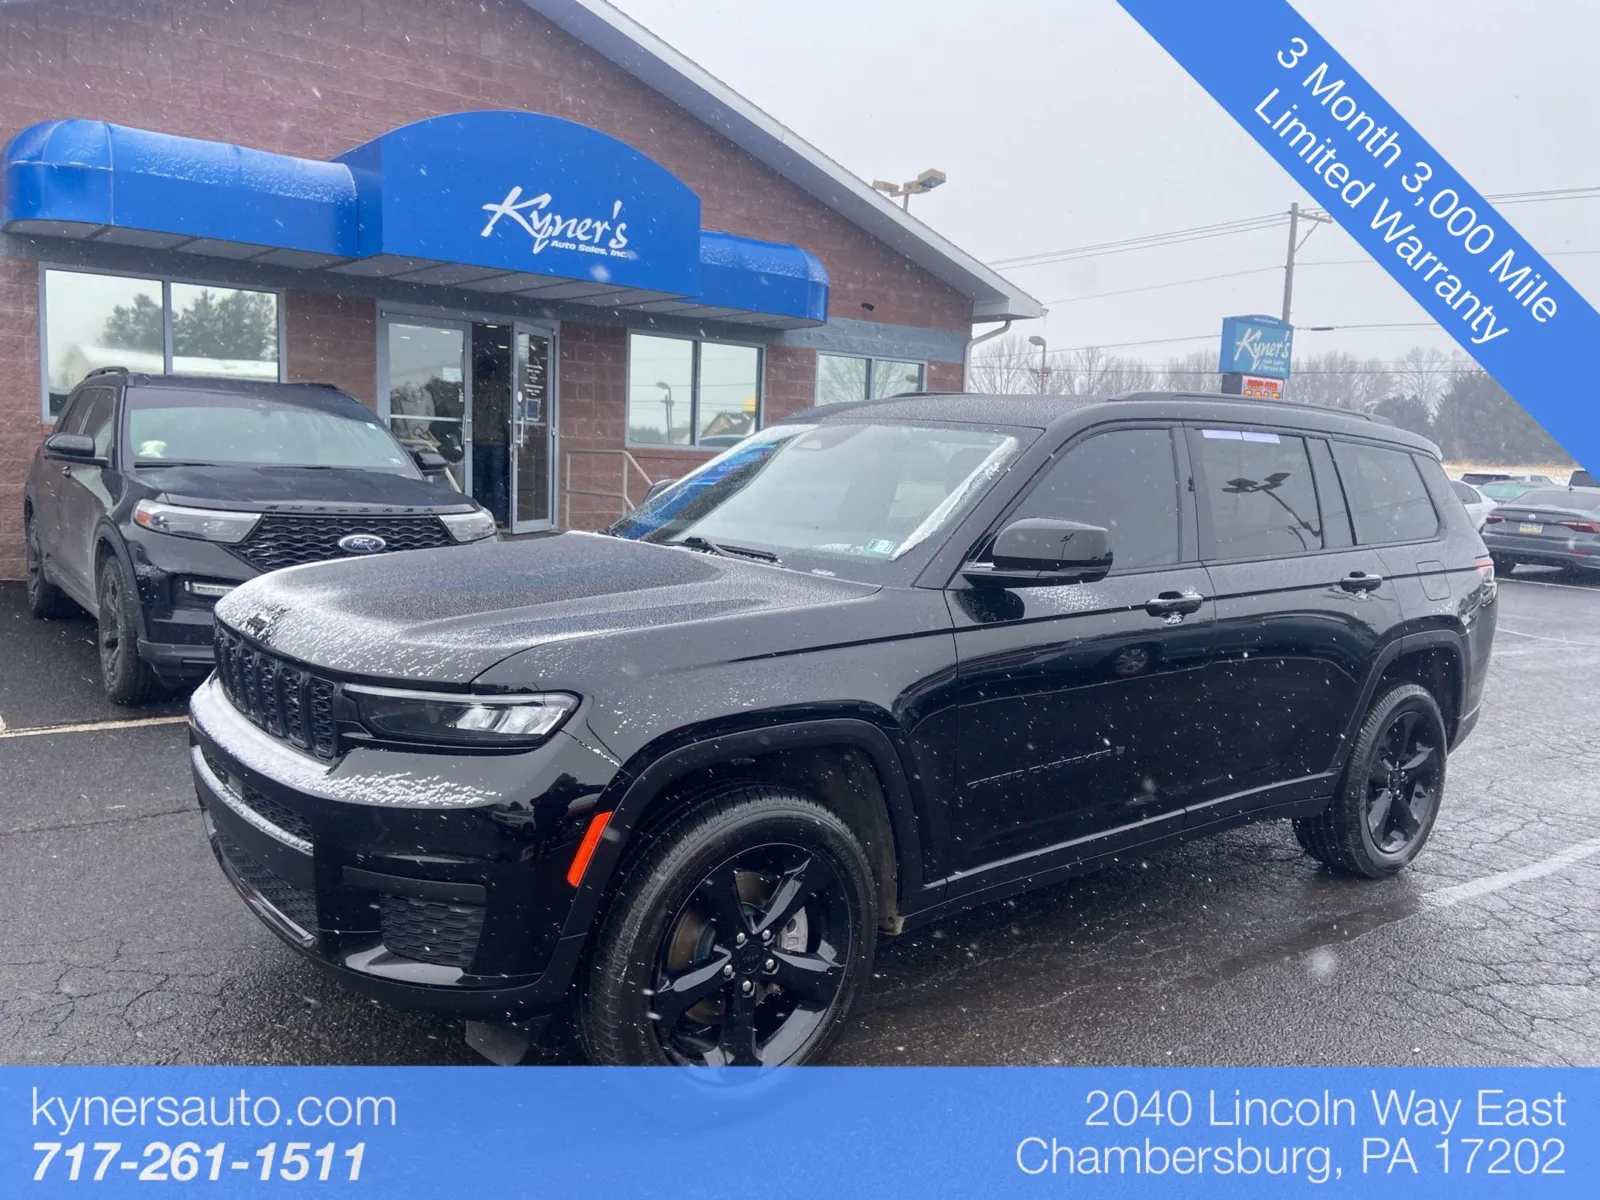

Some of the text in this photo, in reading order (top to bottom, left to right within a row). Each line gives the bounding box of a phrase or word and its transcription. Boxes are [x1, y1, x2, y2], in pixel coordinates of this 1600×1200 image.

[480, 185, 629, 255] Kyner's
[550, 239, 577, 251] Auto
[577, 243, 608, 256] Sales,
[1234, 328, 1290, 372] Kyner's
[350, 538, 376, 550] Ford
